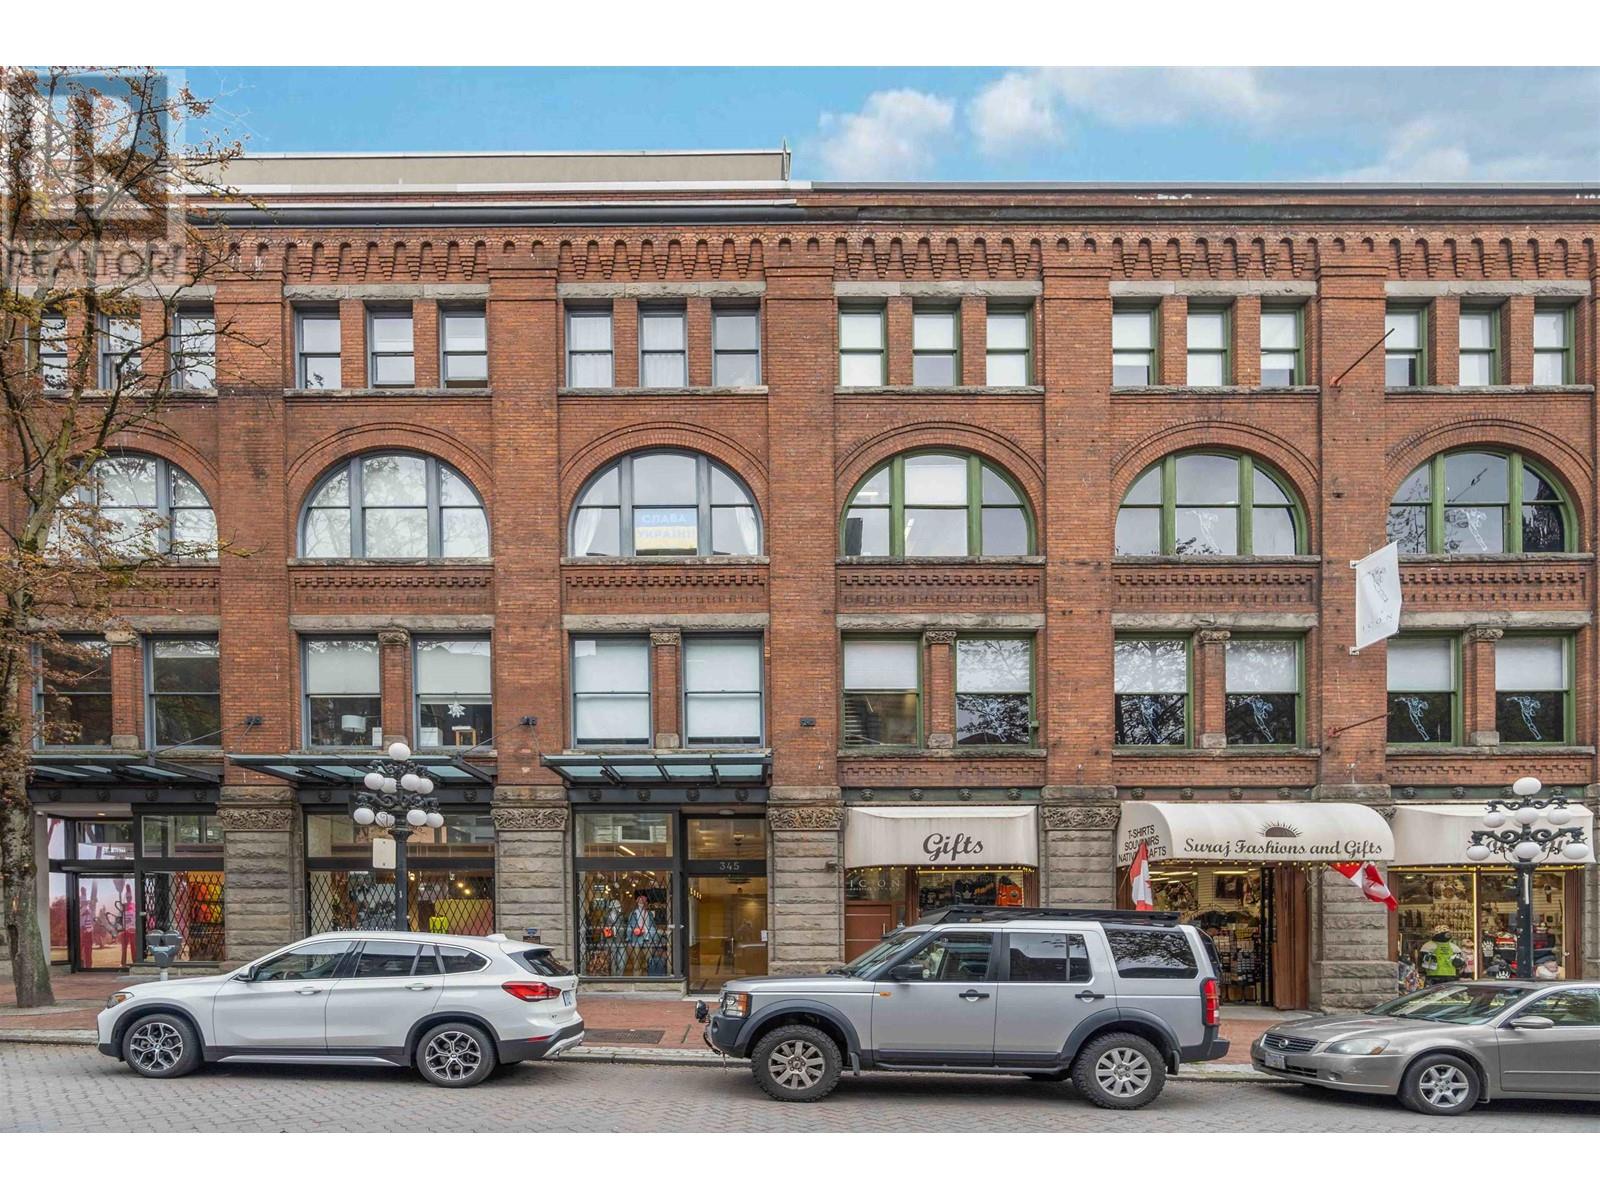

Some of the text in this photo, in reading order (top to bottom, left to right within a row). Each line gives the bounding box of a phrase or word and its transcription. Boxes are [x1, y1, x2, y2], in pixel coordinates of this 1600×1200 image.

[1128, 824, 1154, 839] T-SHIRTS
[923, 833, 983, 860] Gifts
[1184, 838, 1382, 858] Suraj Fashions and Gifts
[719, 861, 740, 871] 345
